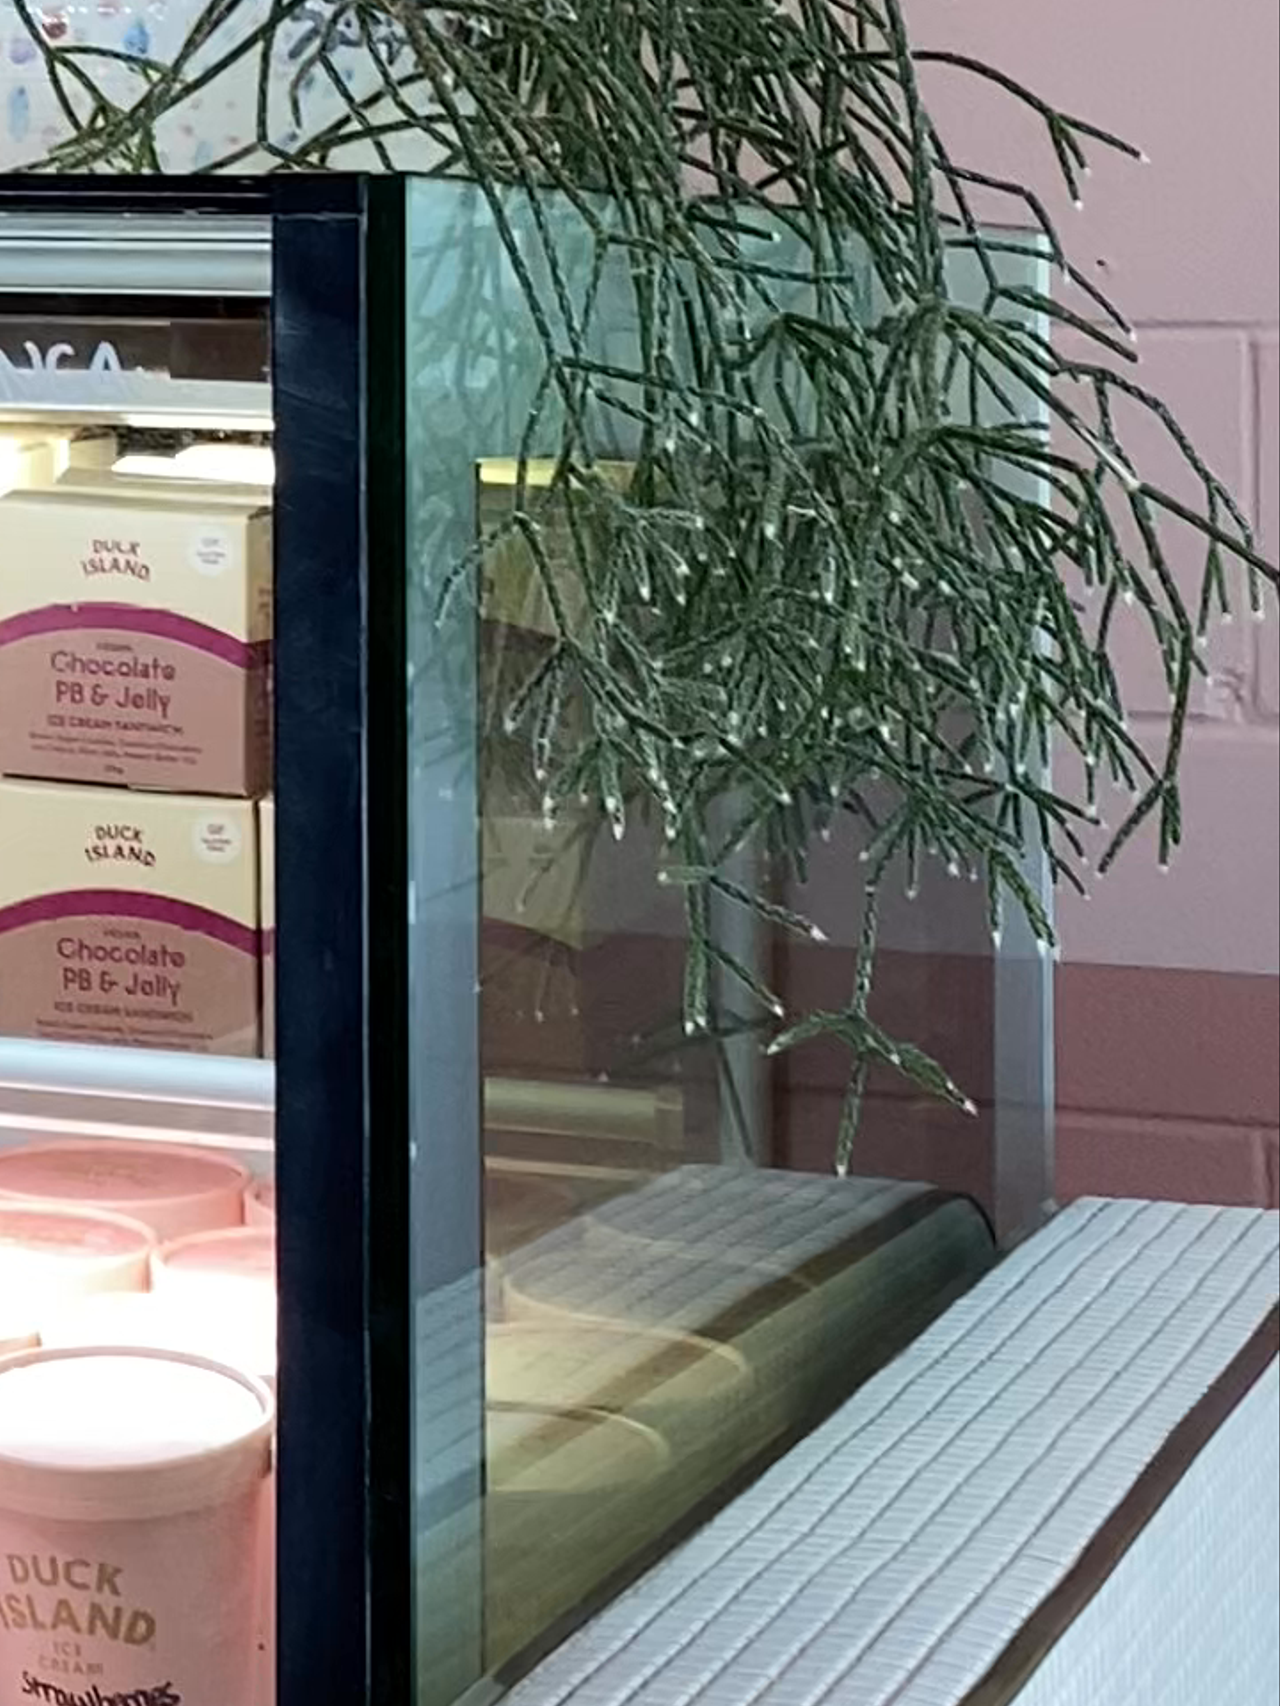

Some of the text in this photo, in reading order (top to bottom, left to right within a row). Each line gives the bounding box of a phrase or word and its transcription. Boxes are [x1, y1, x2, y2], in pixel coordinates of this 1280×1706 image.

[79, 556, 152, 583] ISLAND
[49, 650, 177, 681] Chocolate
[55, 680, 85, 705] PB
[114, 685, 173, 720] Jelly
[94, 824, 143, 845] DUCK
[83, 844, 157, 868] ISLAND
[56, 937, 187, 969] Chocolate
[62, 967, 92, 993] PB
[124, 971, 183, 1007] Jelly
[6, 1552, 125, 1597] DUCK
